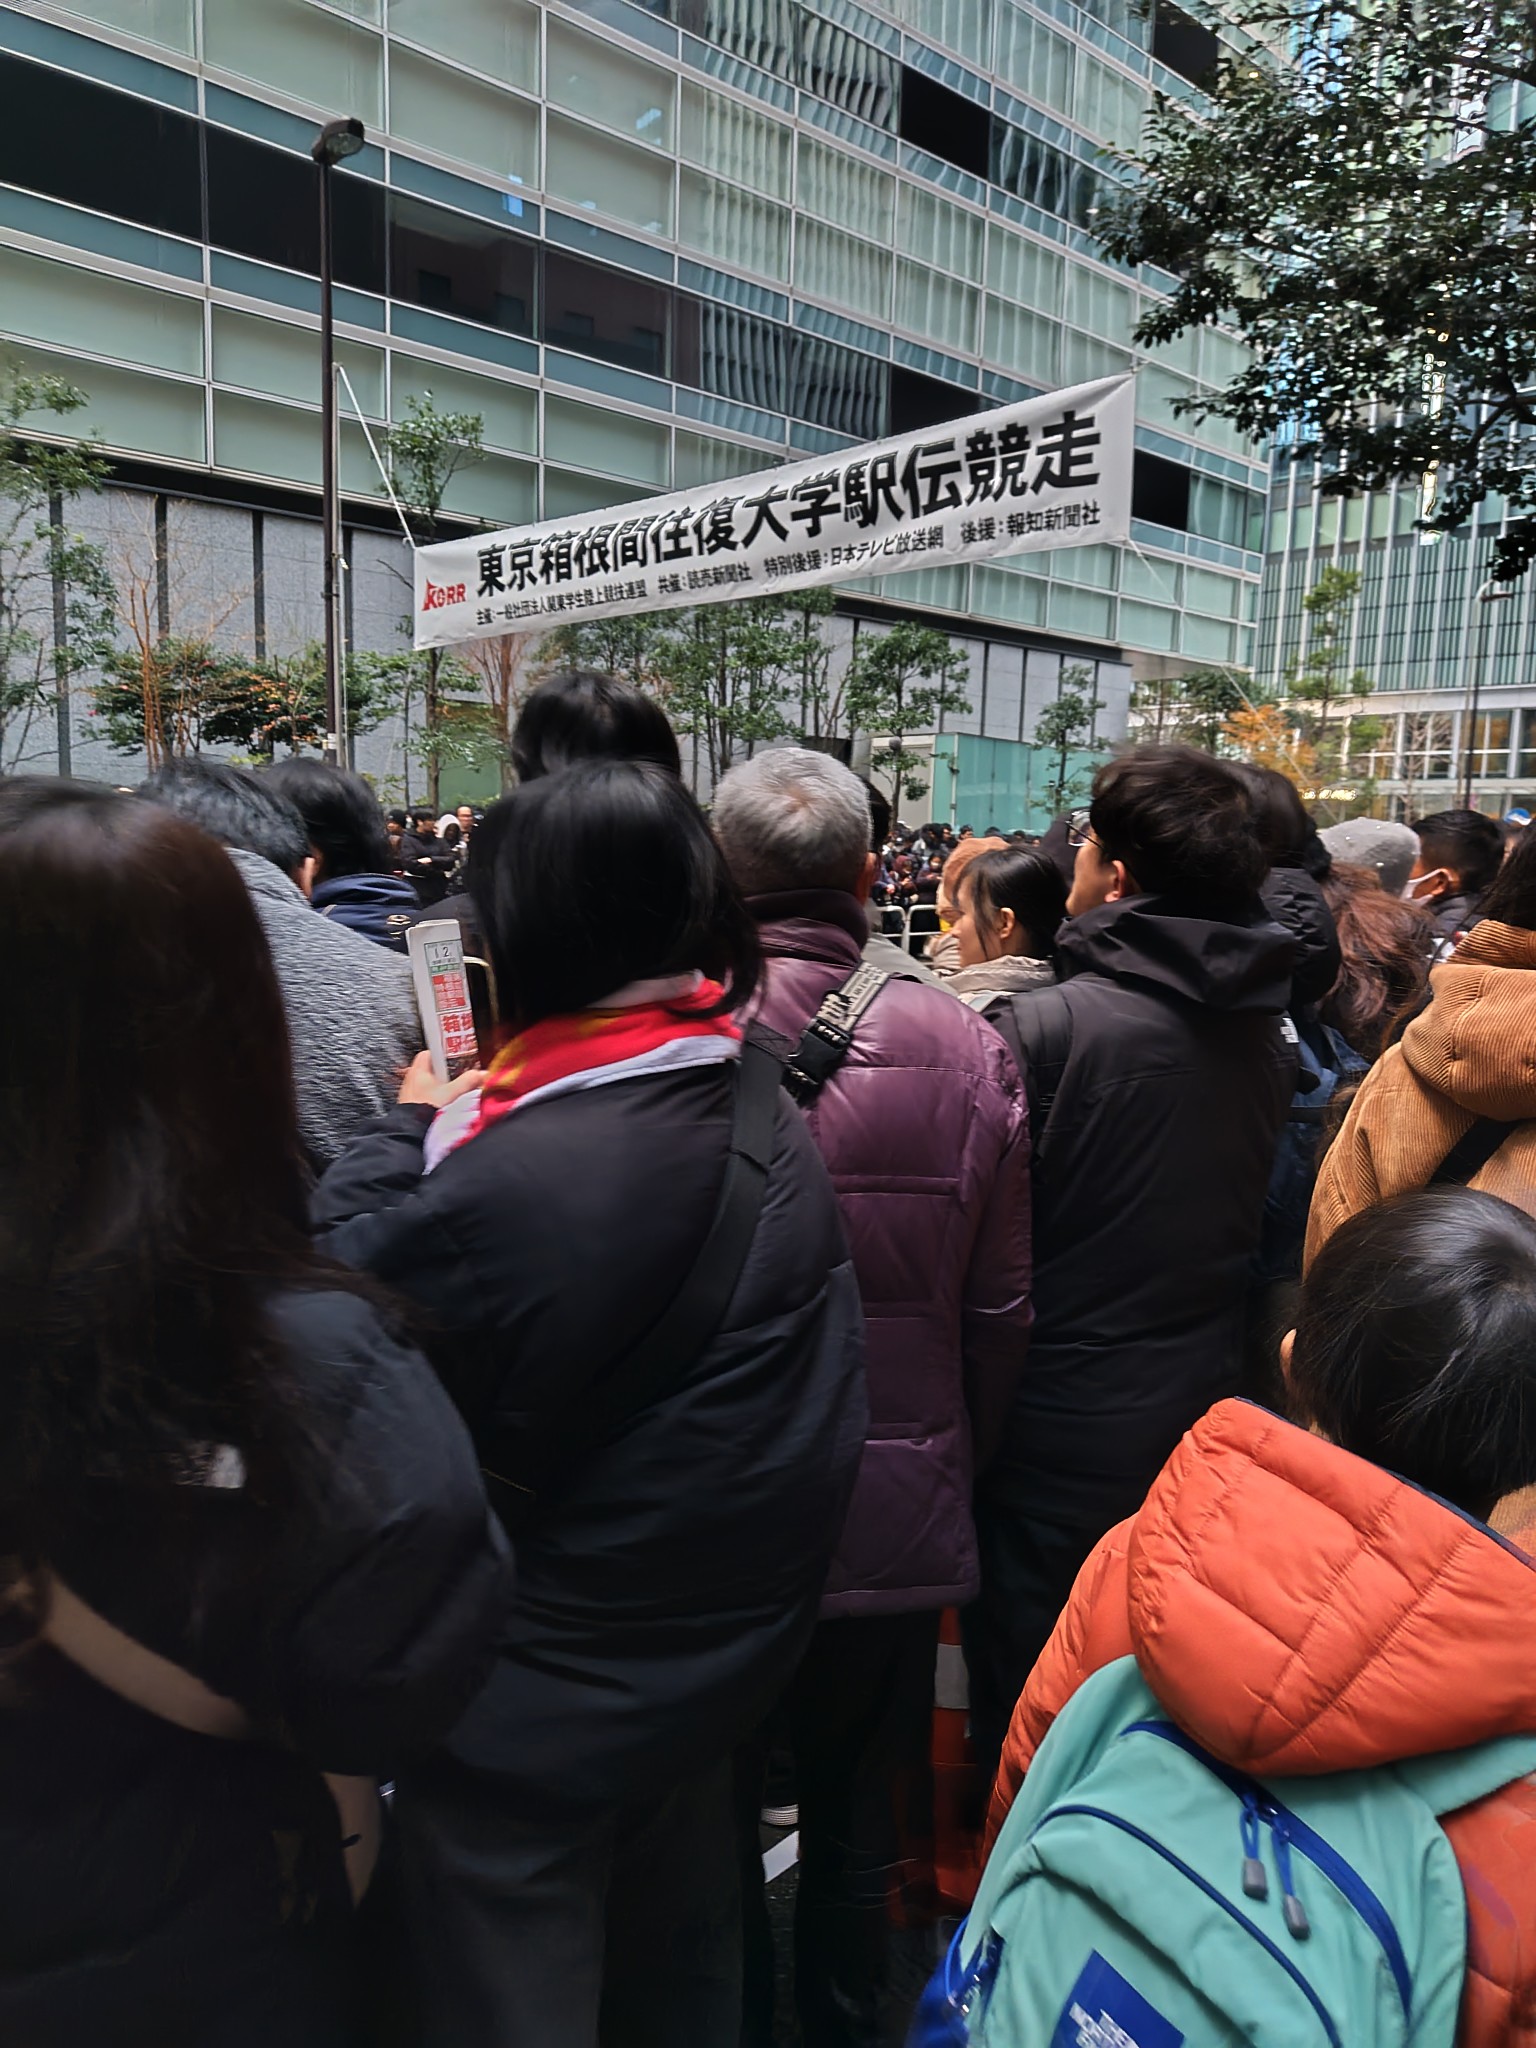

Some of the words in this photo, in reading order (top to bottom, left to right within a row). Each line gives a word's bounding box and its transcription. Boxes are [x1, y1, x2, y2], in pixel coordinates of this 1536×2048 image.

[476, 410, 1101, 597] 東京箱根間往復大学駅伝競走
